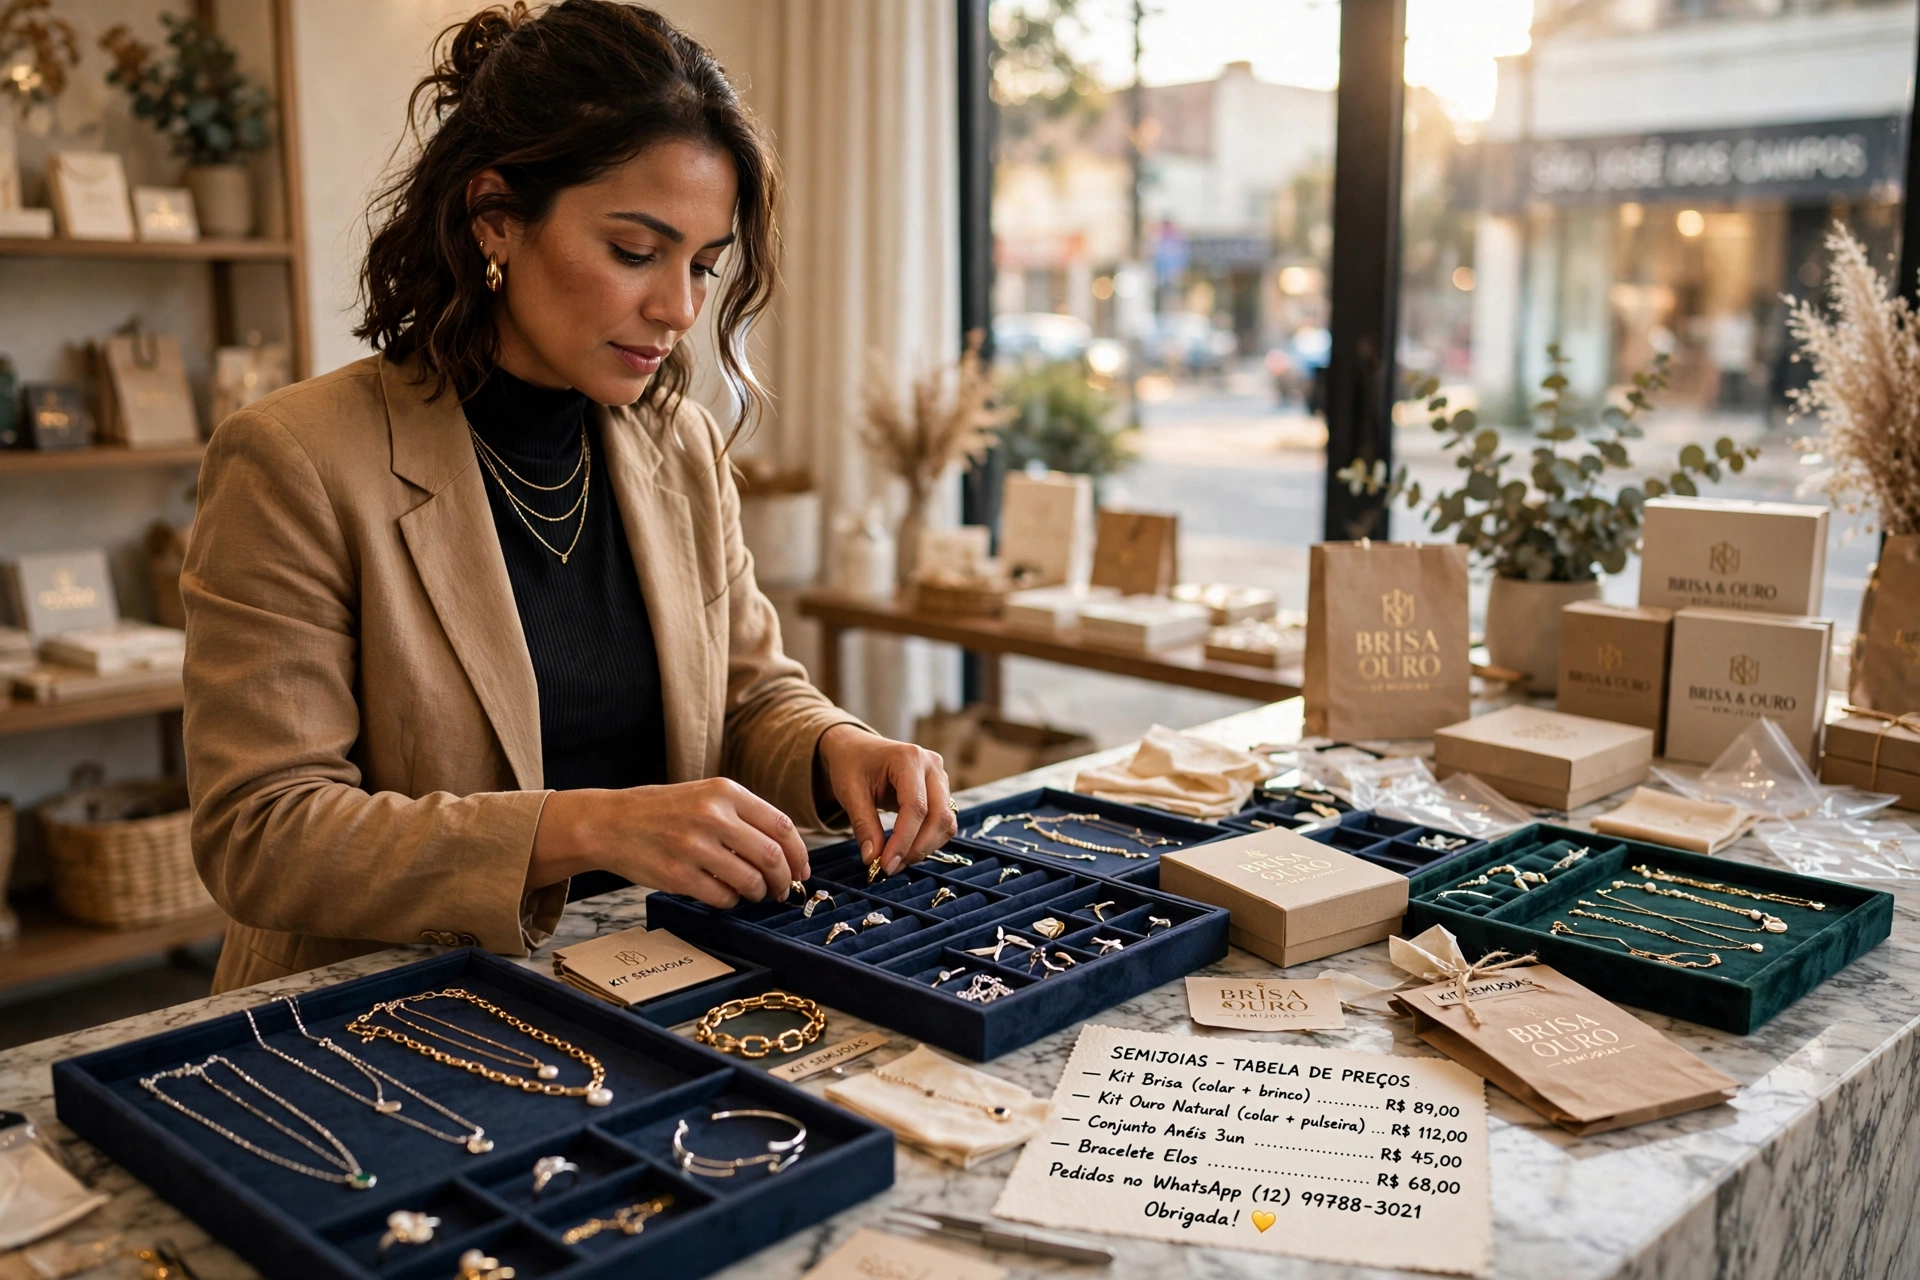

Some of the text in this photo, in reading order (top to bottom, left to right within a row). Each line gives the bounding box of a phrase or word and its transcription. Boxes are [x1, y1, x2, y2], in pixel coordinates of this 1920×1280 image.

[1667, 576, 1712, 594] BRISA
[1730, 582, 1777, 600] OURO
[1356, 629, 1439, 655] BRISA
[1358, 653, 1441, 680] OURO
[1689, 685, 1731, 703] BRISA
[1750, 693, 1797, 712] OURO
[1237, 852, 1311, 874] BRISA
[1261, 860, 1332, 881] OURO
[608, 956, 694, 988] KIT SEMIJOIAS
[1221, 988, 1304, 1001] BRISA
[1438, 978, 1533, 1001] KIT SEMIJOIAS
[1222, 1000, 1308, 1012] OURO
[1506, 1013, 1600, 1043] BRISA
[1532, 1028, 1619, 1057] OURO
[789, 1038, 869, 1073] KIT SEMIJOIAS
[1110, 1045, 1208, 1068] SEMIJOIAS
[1232, 1058, 1300, 1077] TABELA
[1308, 1065, 1333, 1080] DE
[1341, 1068, 1411, 1090] PREÇOS
[1108, 1068, 1136, 1084] Kit
[1141, 1072, 1183, 1089] Brisa
[1191, 1076, 1236, 1094] (colar
[1258, 1083, 1311, 1104] brinco)
[1385, 1098, 1406, 1114] R$
[1413, 1101, 1460, 1118] 89,00
[1097, 1090, 1124, 1106] Kit
[1129, 1094, 1166, 1111] Ouro
[1171, 1099, 1231, 1118] Natural
[1237, 1105, 1280, 1123] (colar
[1300, 1114, 1366, 1135] pulseira)
[1390, 1123, 1411, 1139] R$
[1418, 1126, 1468, 1144] 112,00
[1087, 1114, 1157, 1136] Conjunto
[1163, 1123, 1207, 1140] Anéis
[1214, 1128, 1245, 1145] 3un
[1380, 1147, 1402, 1164] R$
[1410, 1149, 1463, 1169] 45,00
[1077, 1138, 1155, 1161] Bracelete
[1163, 1148, 1198, 1166] Elos
[1376, 1172, 1400, 1190] R$
[1408, 1176, 1461, 1196] 68,00
[1048, 1161, 1422, 1220] Pedidos no WhatsApp (12) 99788-3021
[1144, 1200, 1241, 1229] Obrigada!
